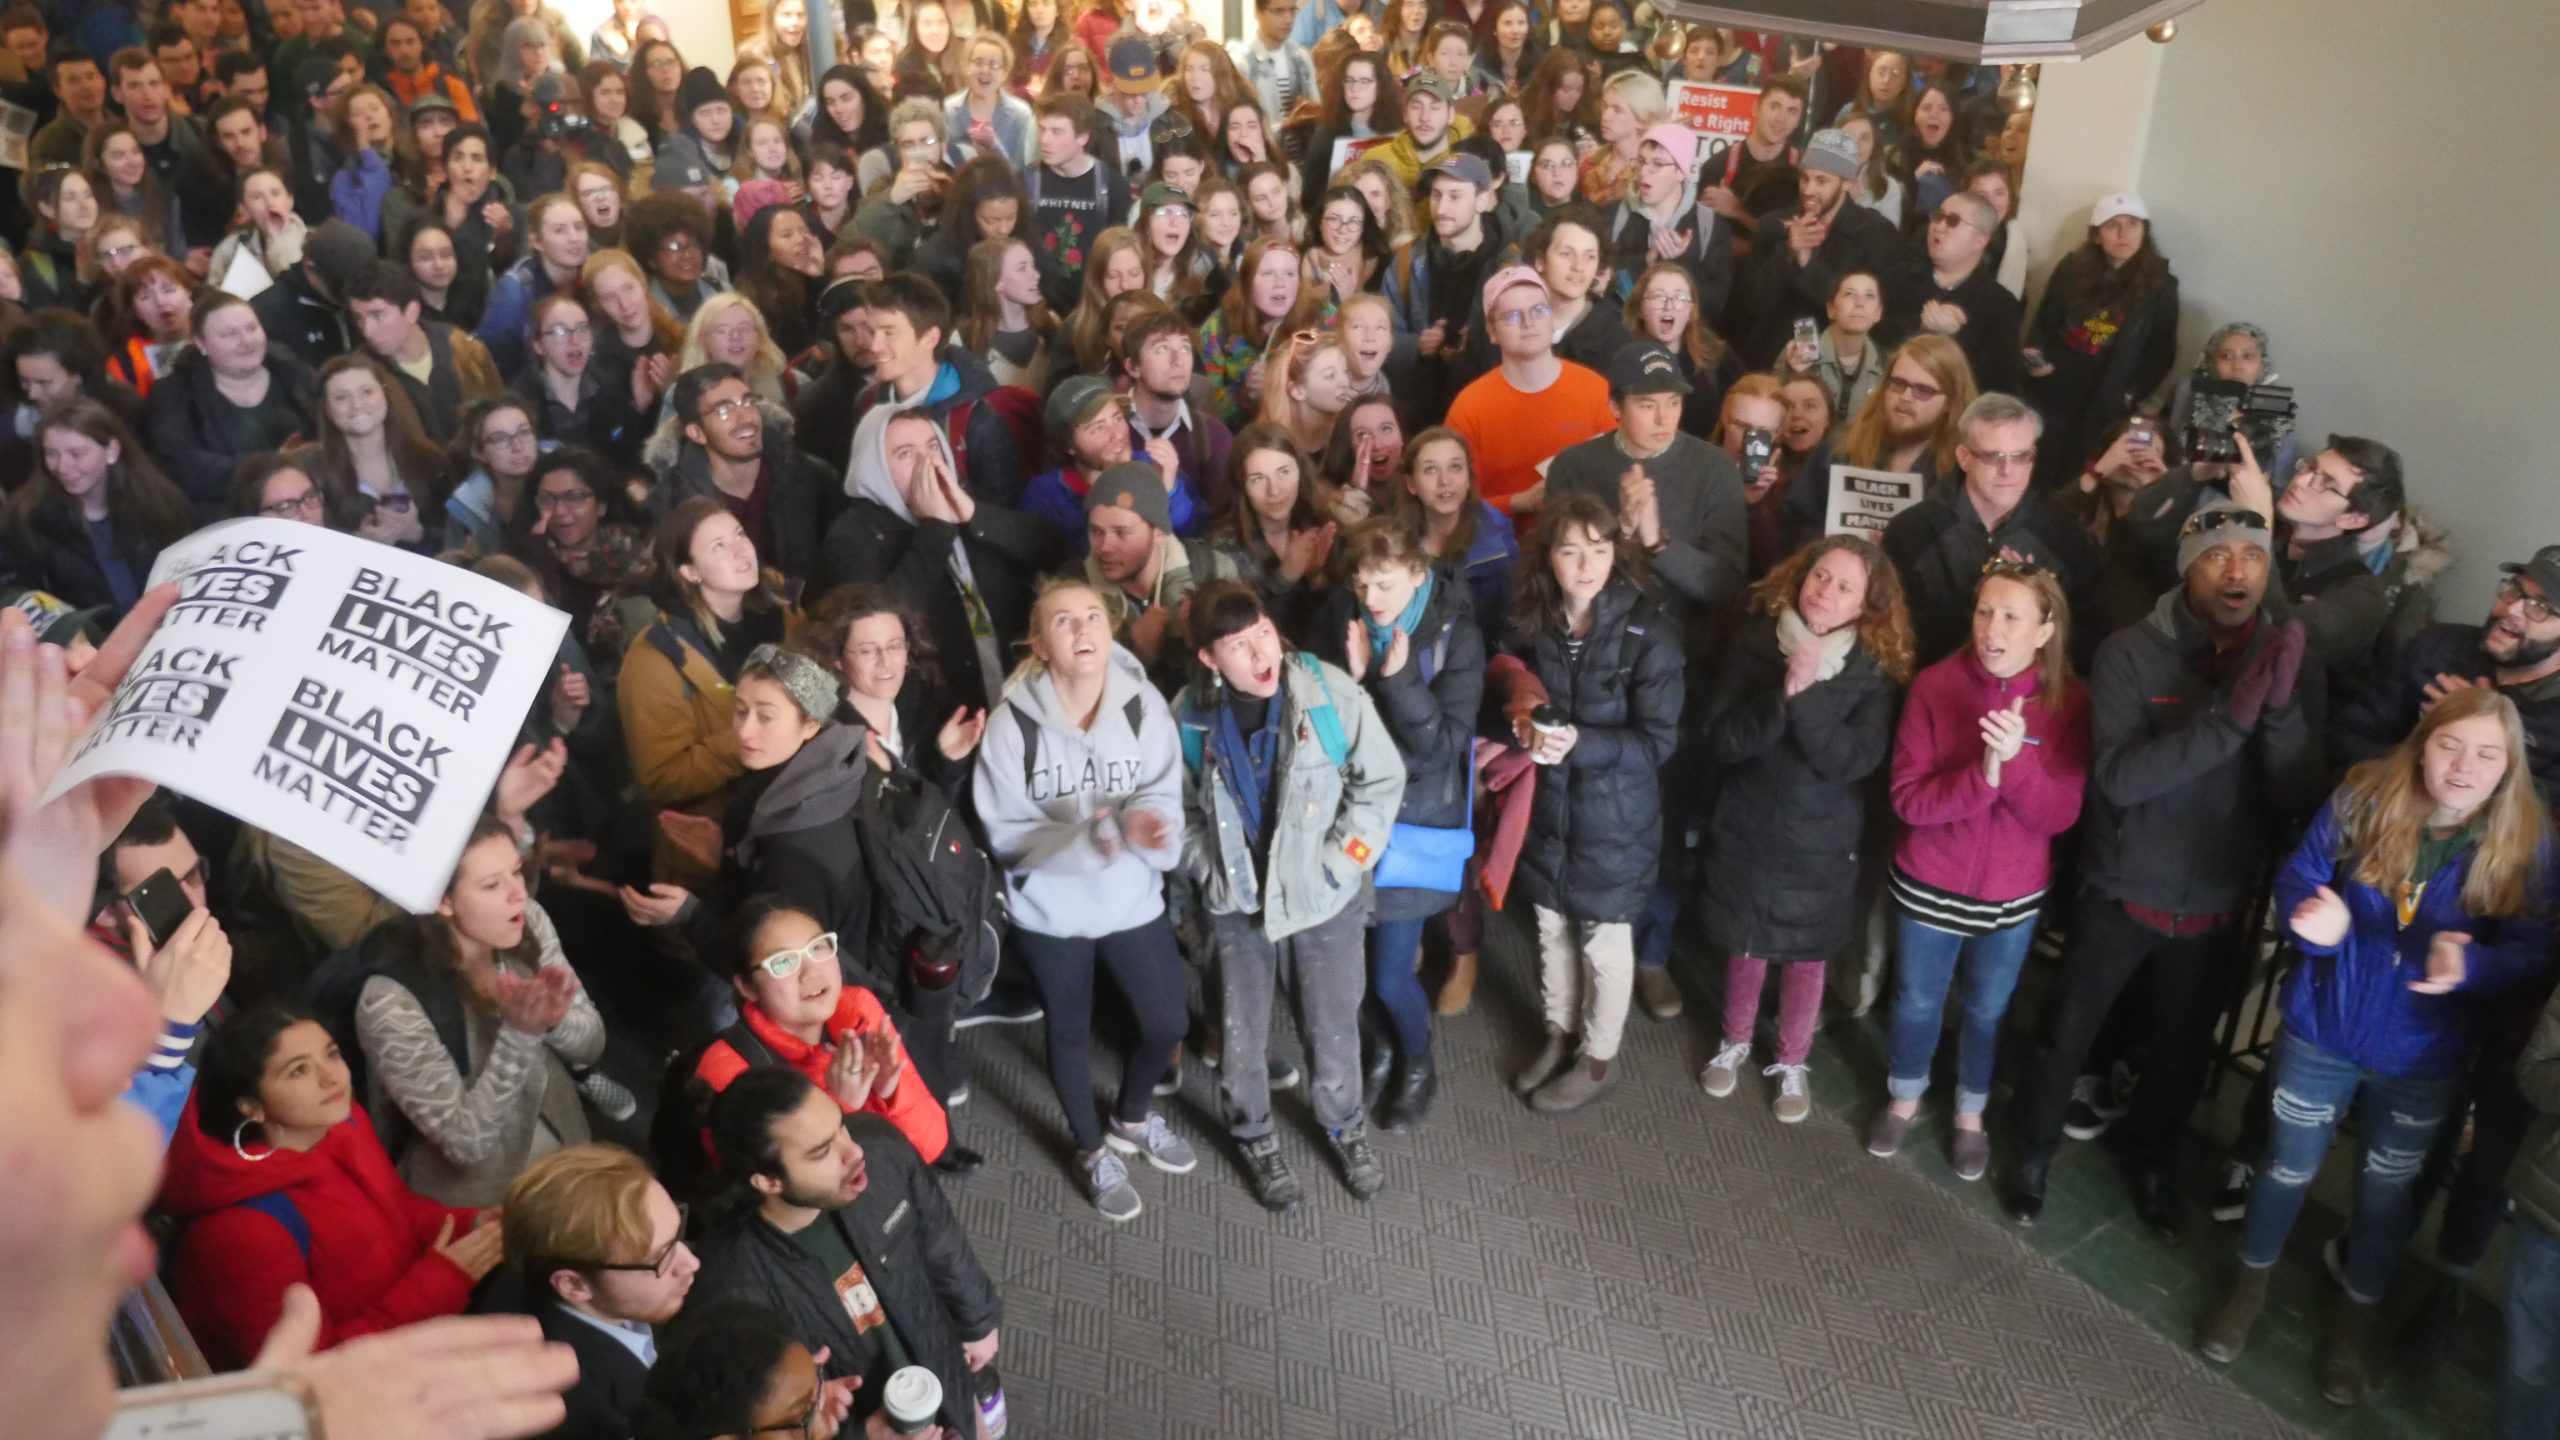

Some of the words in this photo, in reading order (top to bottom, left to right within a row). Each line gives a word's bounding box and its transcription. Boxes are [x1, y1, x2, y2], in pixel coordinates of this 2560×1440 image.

[1680, 90, 1729, 109] Resist
[1707, 114, 1751, 134] Right
[1038, 198, 1096, 211] WHITNEY
[1853, 480, 1900, 497] BLACK
[1859, 498, 1895, 513] LIVES
[181, 571, 276, 604] VES
[172, 604, 268, 633] TTER
[351, 567, 515, 650] BLACK
[343, 601, 486, 684] LIVES
[128, 646, 242, 684] ACK
[317, 632, 477, 723] MATTER
[117, 680, 210, 718] VES
[291, 676, 454, 779] BLACK
[282, 716, 422, 813] LIVES
[253, 752, 411, 854] MATTER
